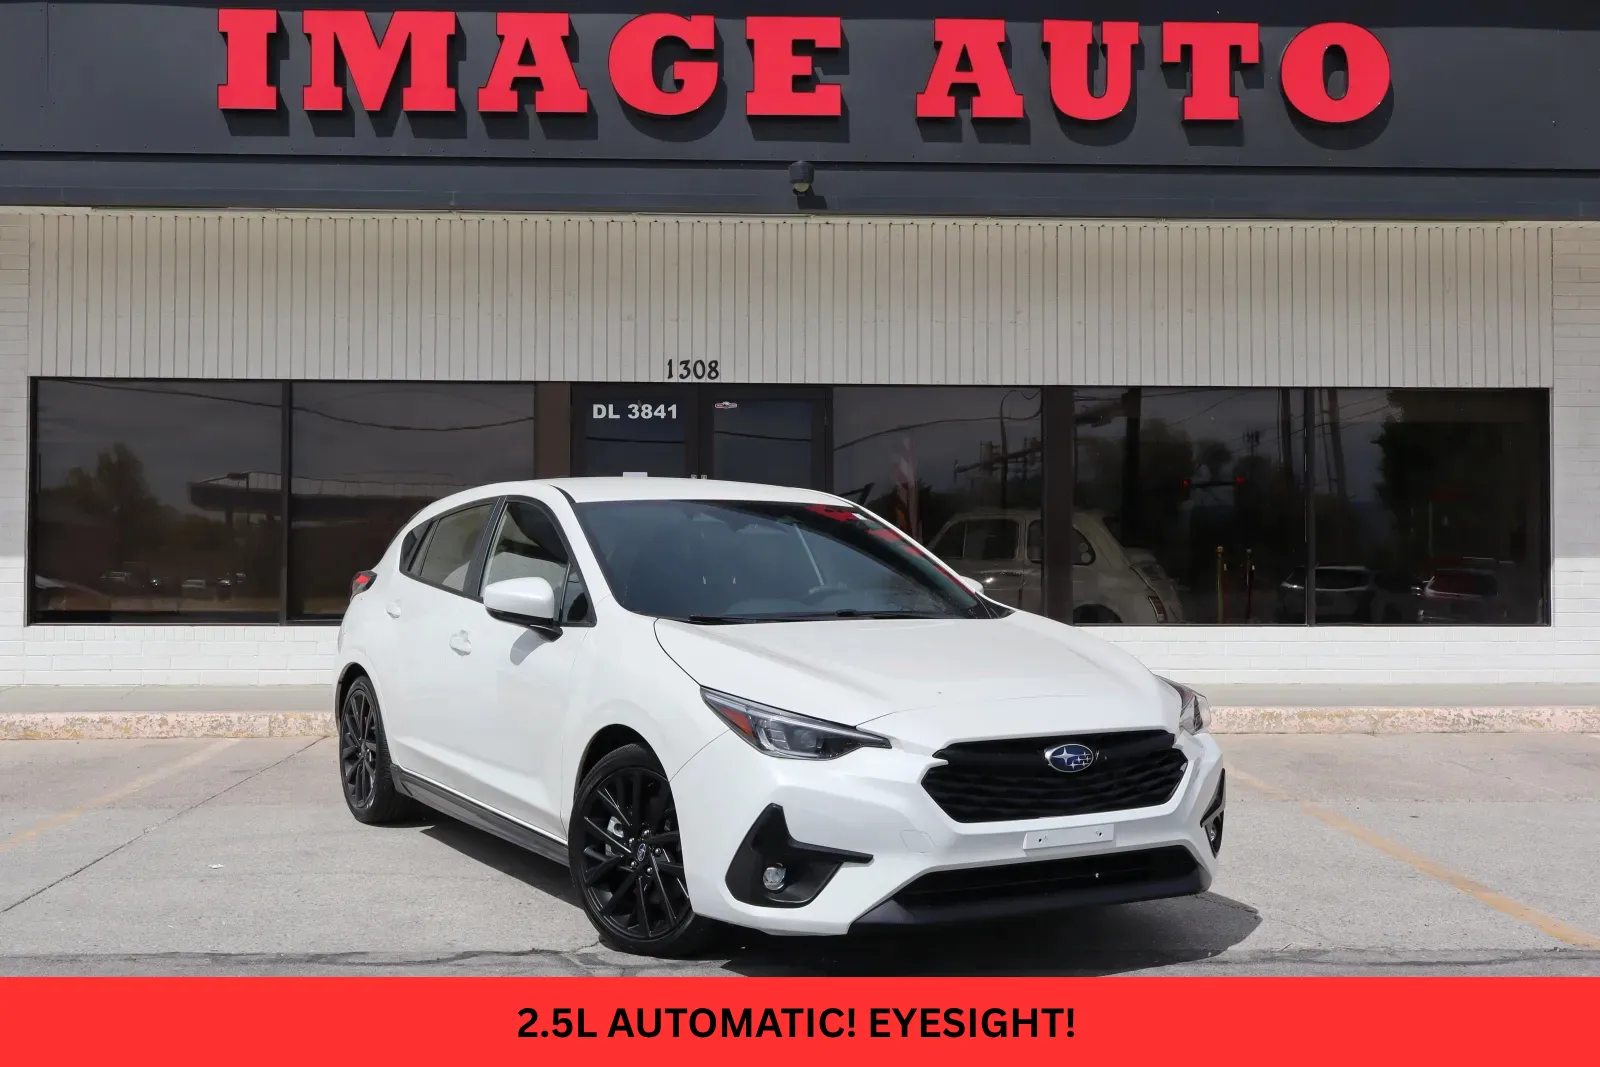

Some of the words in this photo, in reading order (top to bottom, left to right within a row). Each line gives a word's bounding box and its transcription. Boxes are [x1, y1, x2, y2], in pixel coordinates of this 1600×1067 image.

[218, 9, 841, 117] IMAGE
[916, 19, 1391, 124] AUTO
[666, 358, 720, 380] 1308
[592, 404, 621, 419] DL
[627, 403, 678, 420] 3841
